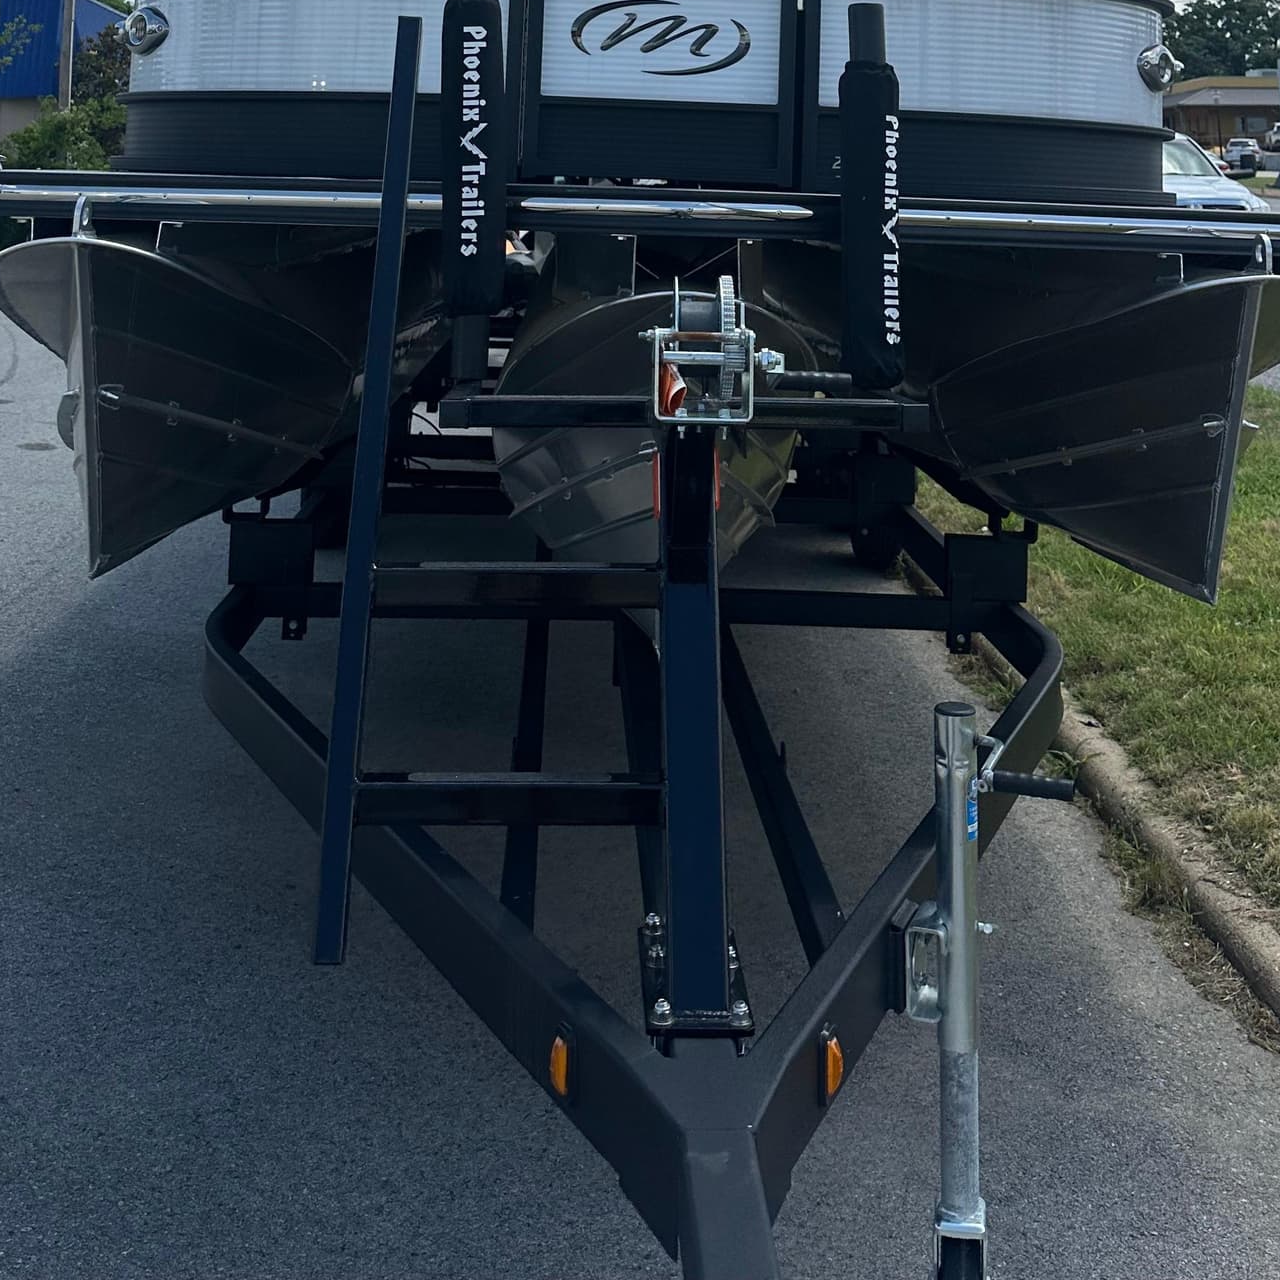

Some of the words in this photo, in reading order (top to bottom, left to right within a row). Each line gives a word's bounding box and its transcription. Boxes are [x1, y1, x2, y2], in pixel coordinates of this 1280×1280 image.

[462, 25, 488, 121] Phoenix
[460, 160, 486, 257] Trailers
[884, 114, 900, 211] Phoenix
[882, 251, 901, 345] Trailers
